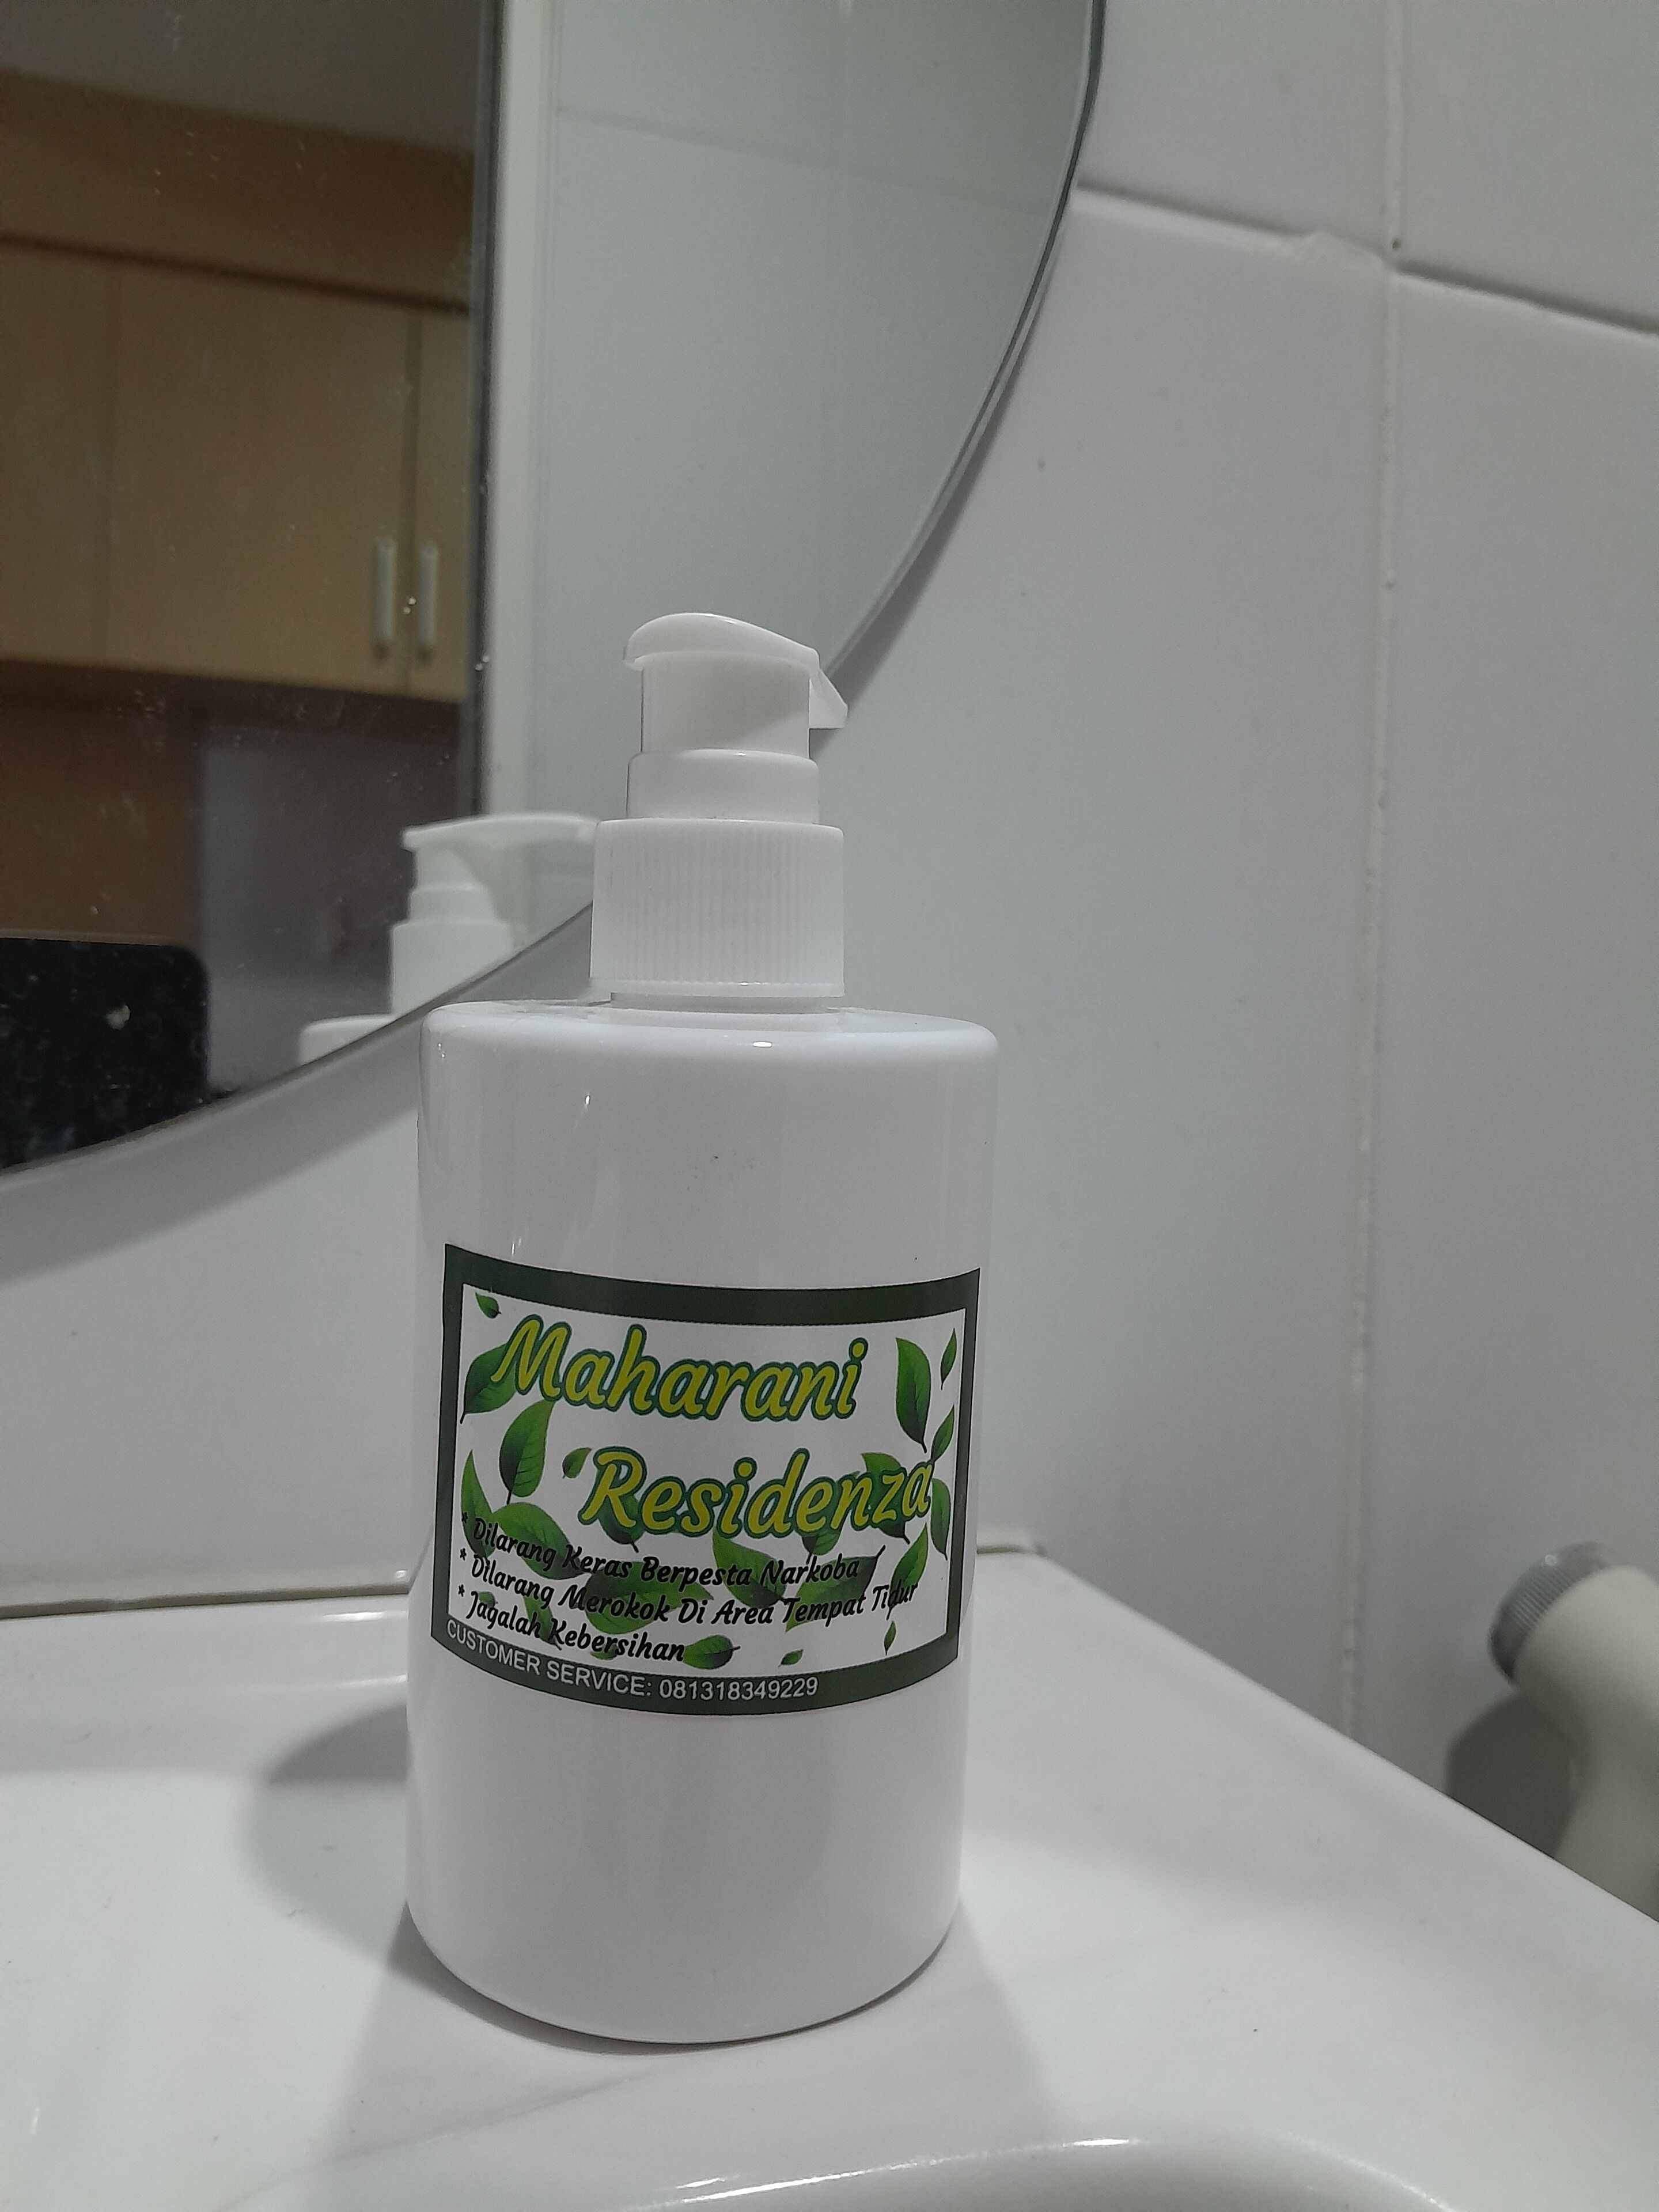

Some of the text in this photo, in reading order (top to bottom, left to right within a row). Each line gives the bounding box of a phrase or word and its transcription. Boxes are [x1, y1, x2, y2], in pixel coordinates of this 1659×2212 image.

[491, 1314, 869, 1422] Maharani
[577, 1445, 933, 1540] Residenza
[471, 1554, 918, 1627] Dilarang Merokok Di Area Tempat Tidur
[474, 1517, 861, 1591] Dilarang Keras Berpesta Narkoba
[447, 1620, 818, 1700] CUSTOMER SERVICE: 081318349229
[467, 1591, 684, 1661] Jagalah Kebersihan
